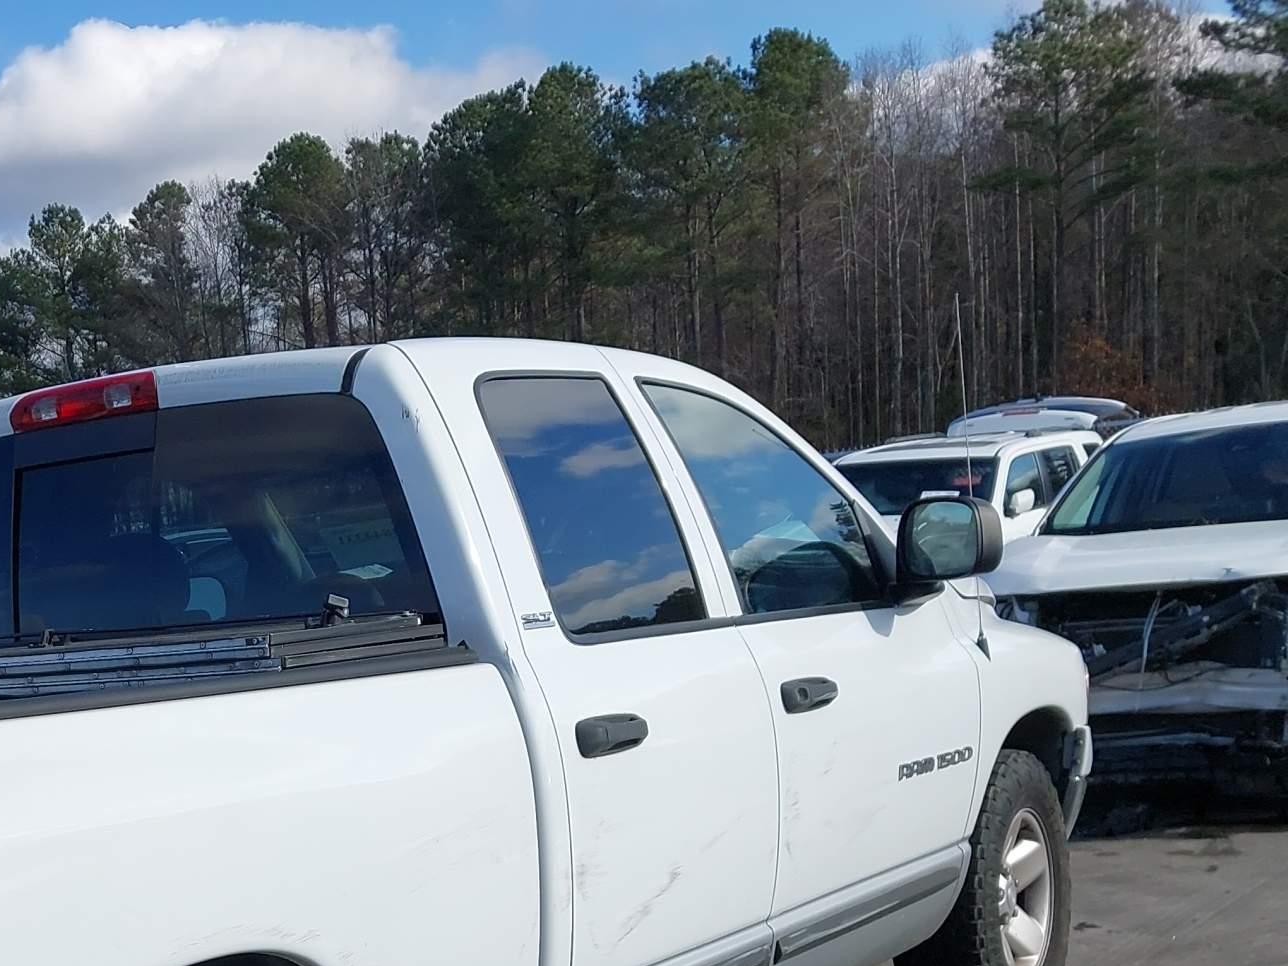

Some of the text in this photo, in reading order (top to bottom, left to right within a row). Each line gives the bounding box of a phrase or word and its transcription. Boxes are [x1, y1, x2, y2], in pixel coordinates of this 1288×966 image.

[521, 611, 552, 623] SLT
[898, 746, 974, 782] RAM 1500
